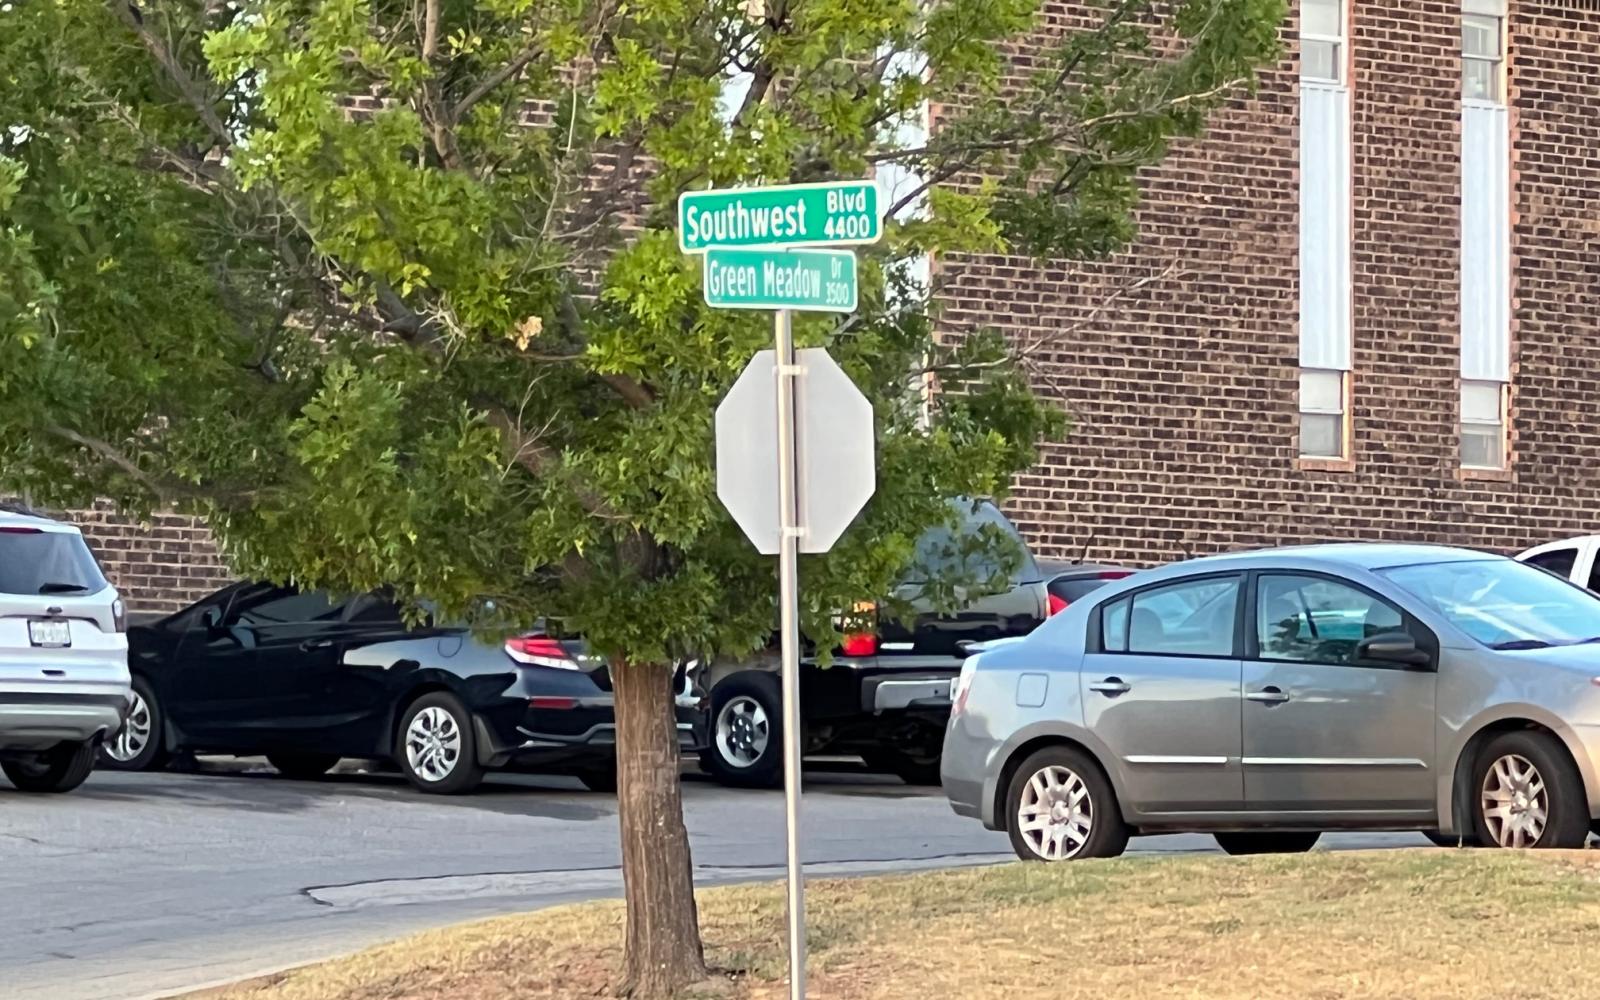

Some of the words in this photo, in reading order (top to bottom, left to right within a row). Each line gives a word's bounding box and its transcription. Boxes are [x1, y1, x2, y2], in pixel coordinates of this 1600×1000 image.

[686, 198, 807, 242] Southwest
[826, 187, 867, 214] Blvd
[823, 214, 871, 239] 4400
[708, 259, 757, 297] Green
[763, 260, 821, 299] Meadow
[830, 256, 843, 279] Dr
[825, 281, 850, 305] 3500
